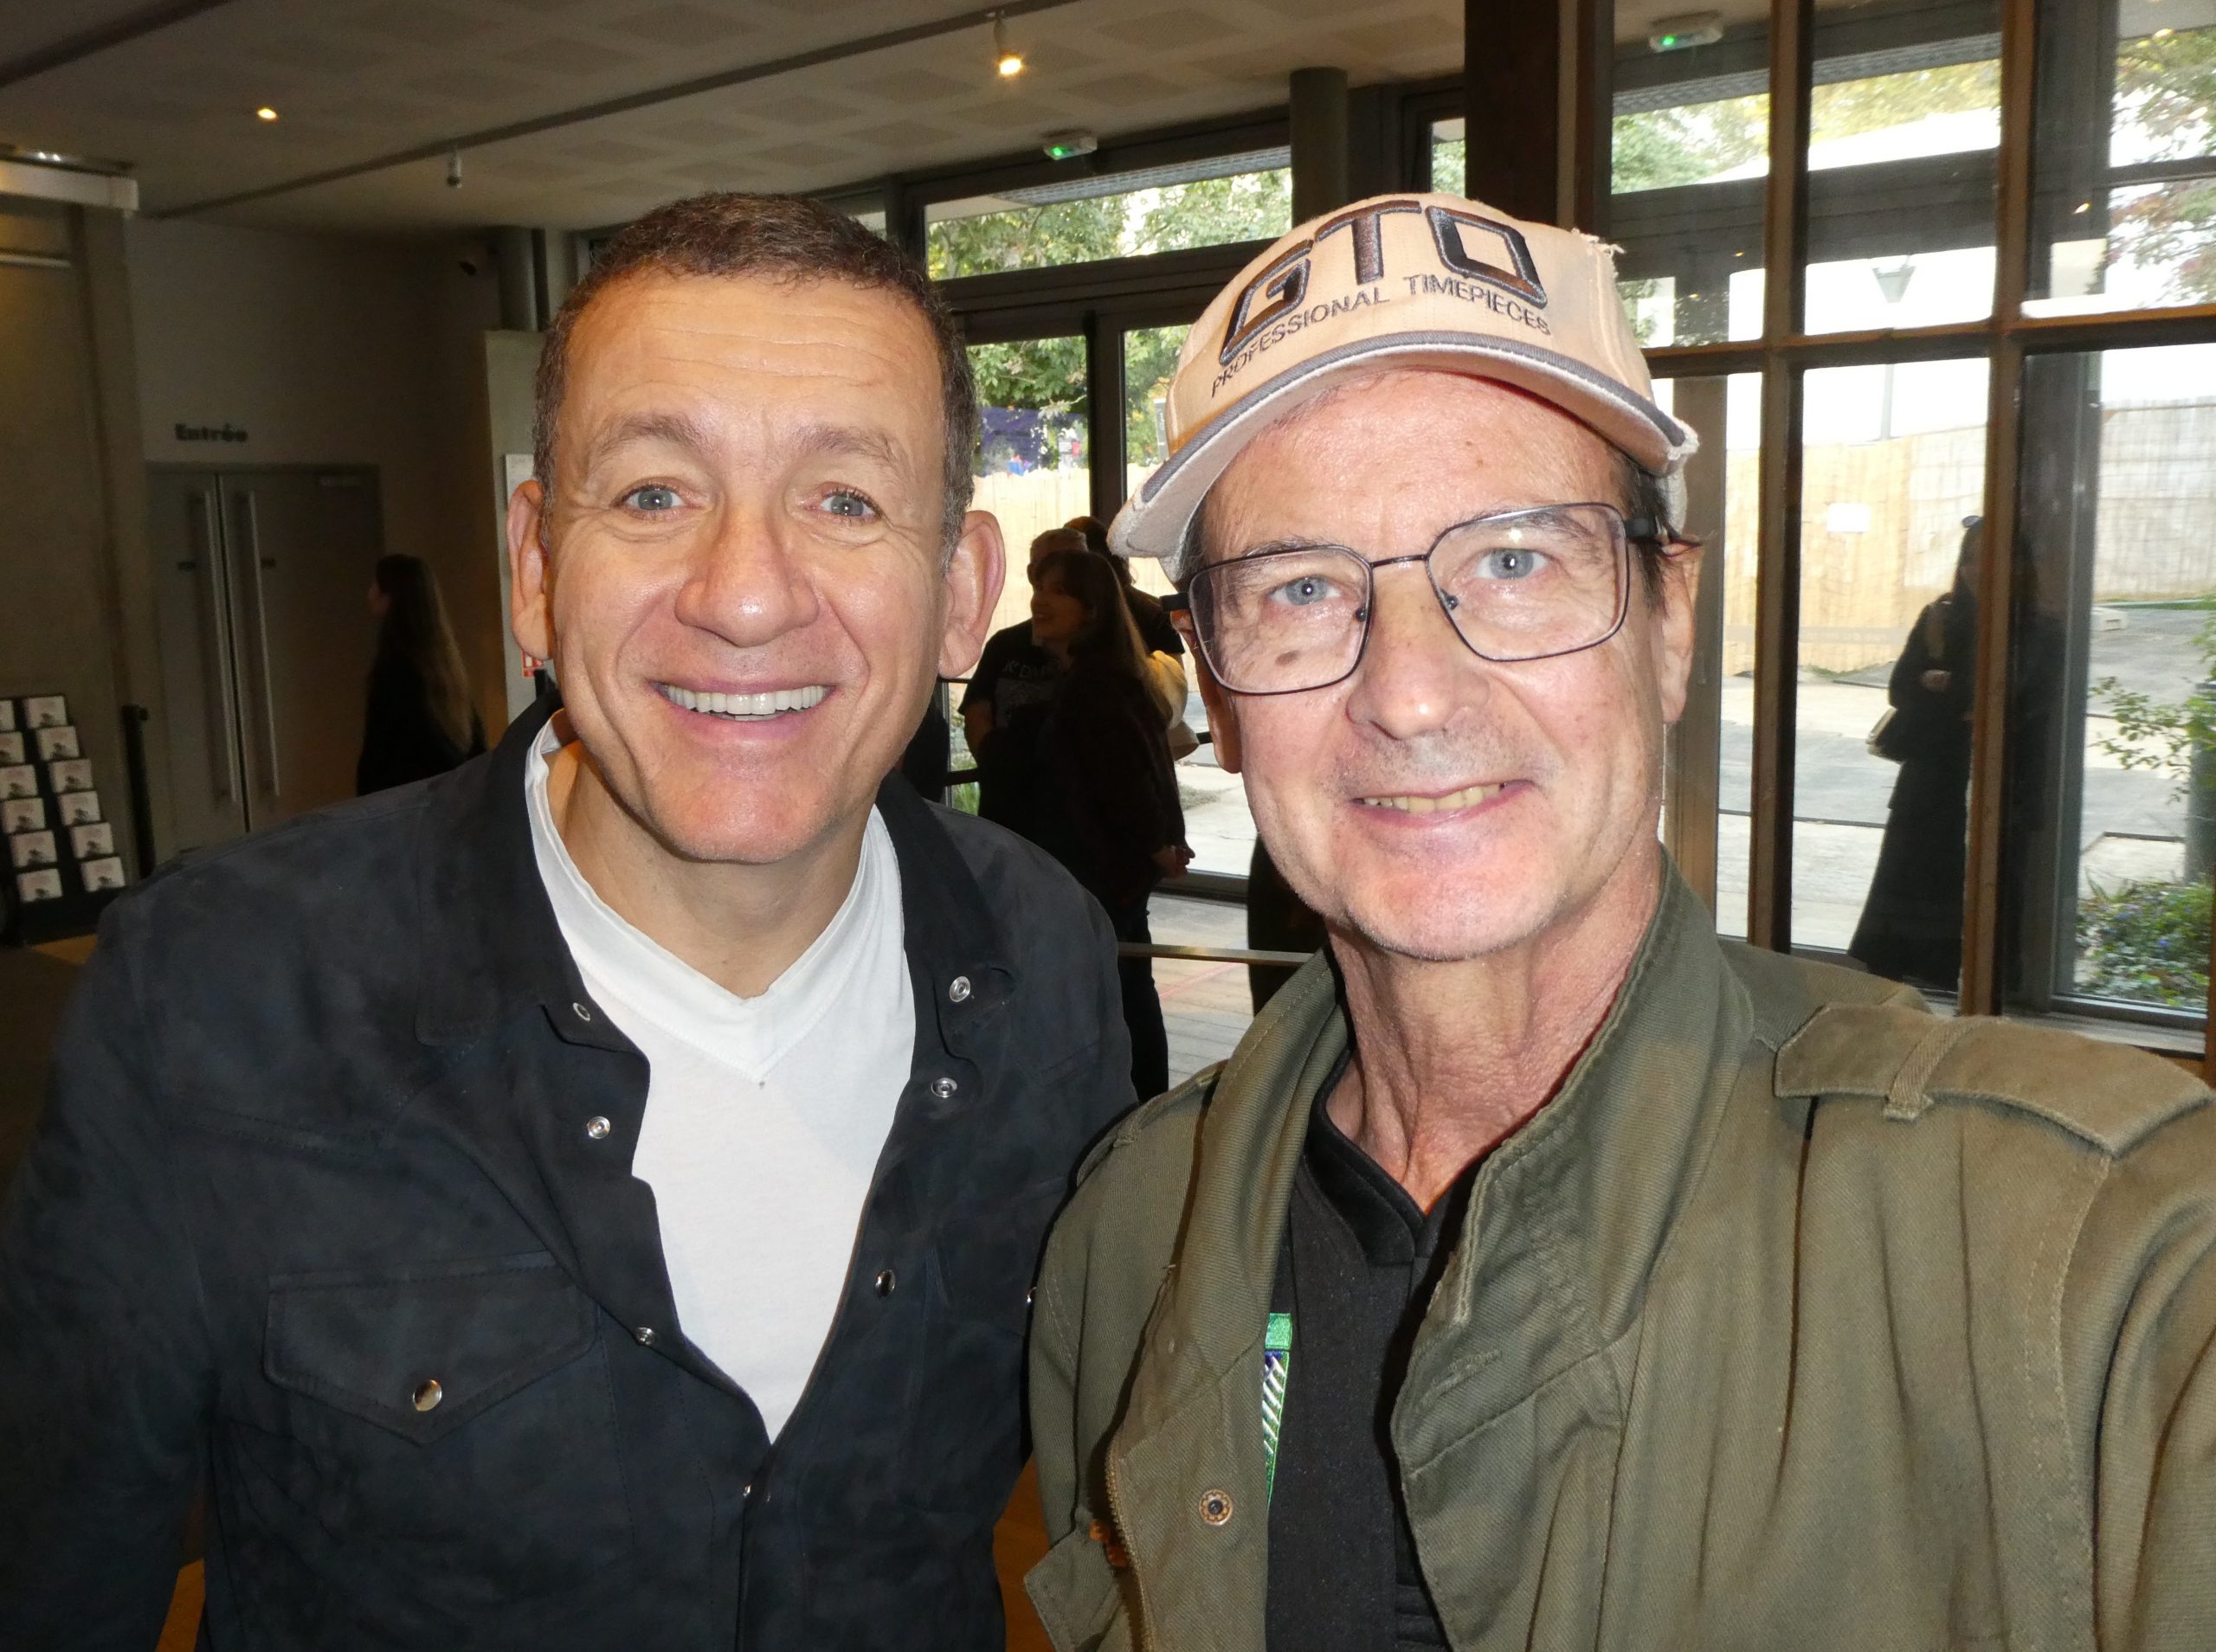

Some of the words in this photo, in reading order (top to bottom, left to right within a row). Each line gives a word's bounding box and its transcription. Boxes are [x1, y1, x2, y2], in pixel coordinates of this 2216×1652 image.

[1211, 287, 1390, 398] PROFESSIONAL
[1403, 273, 1551, 335] TIMEPIECES
[174, 422, 248, 440] Entrée
